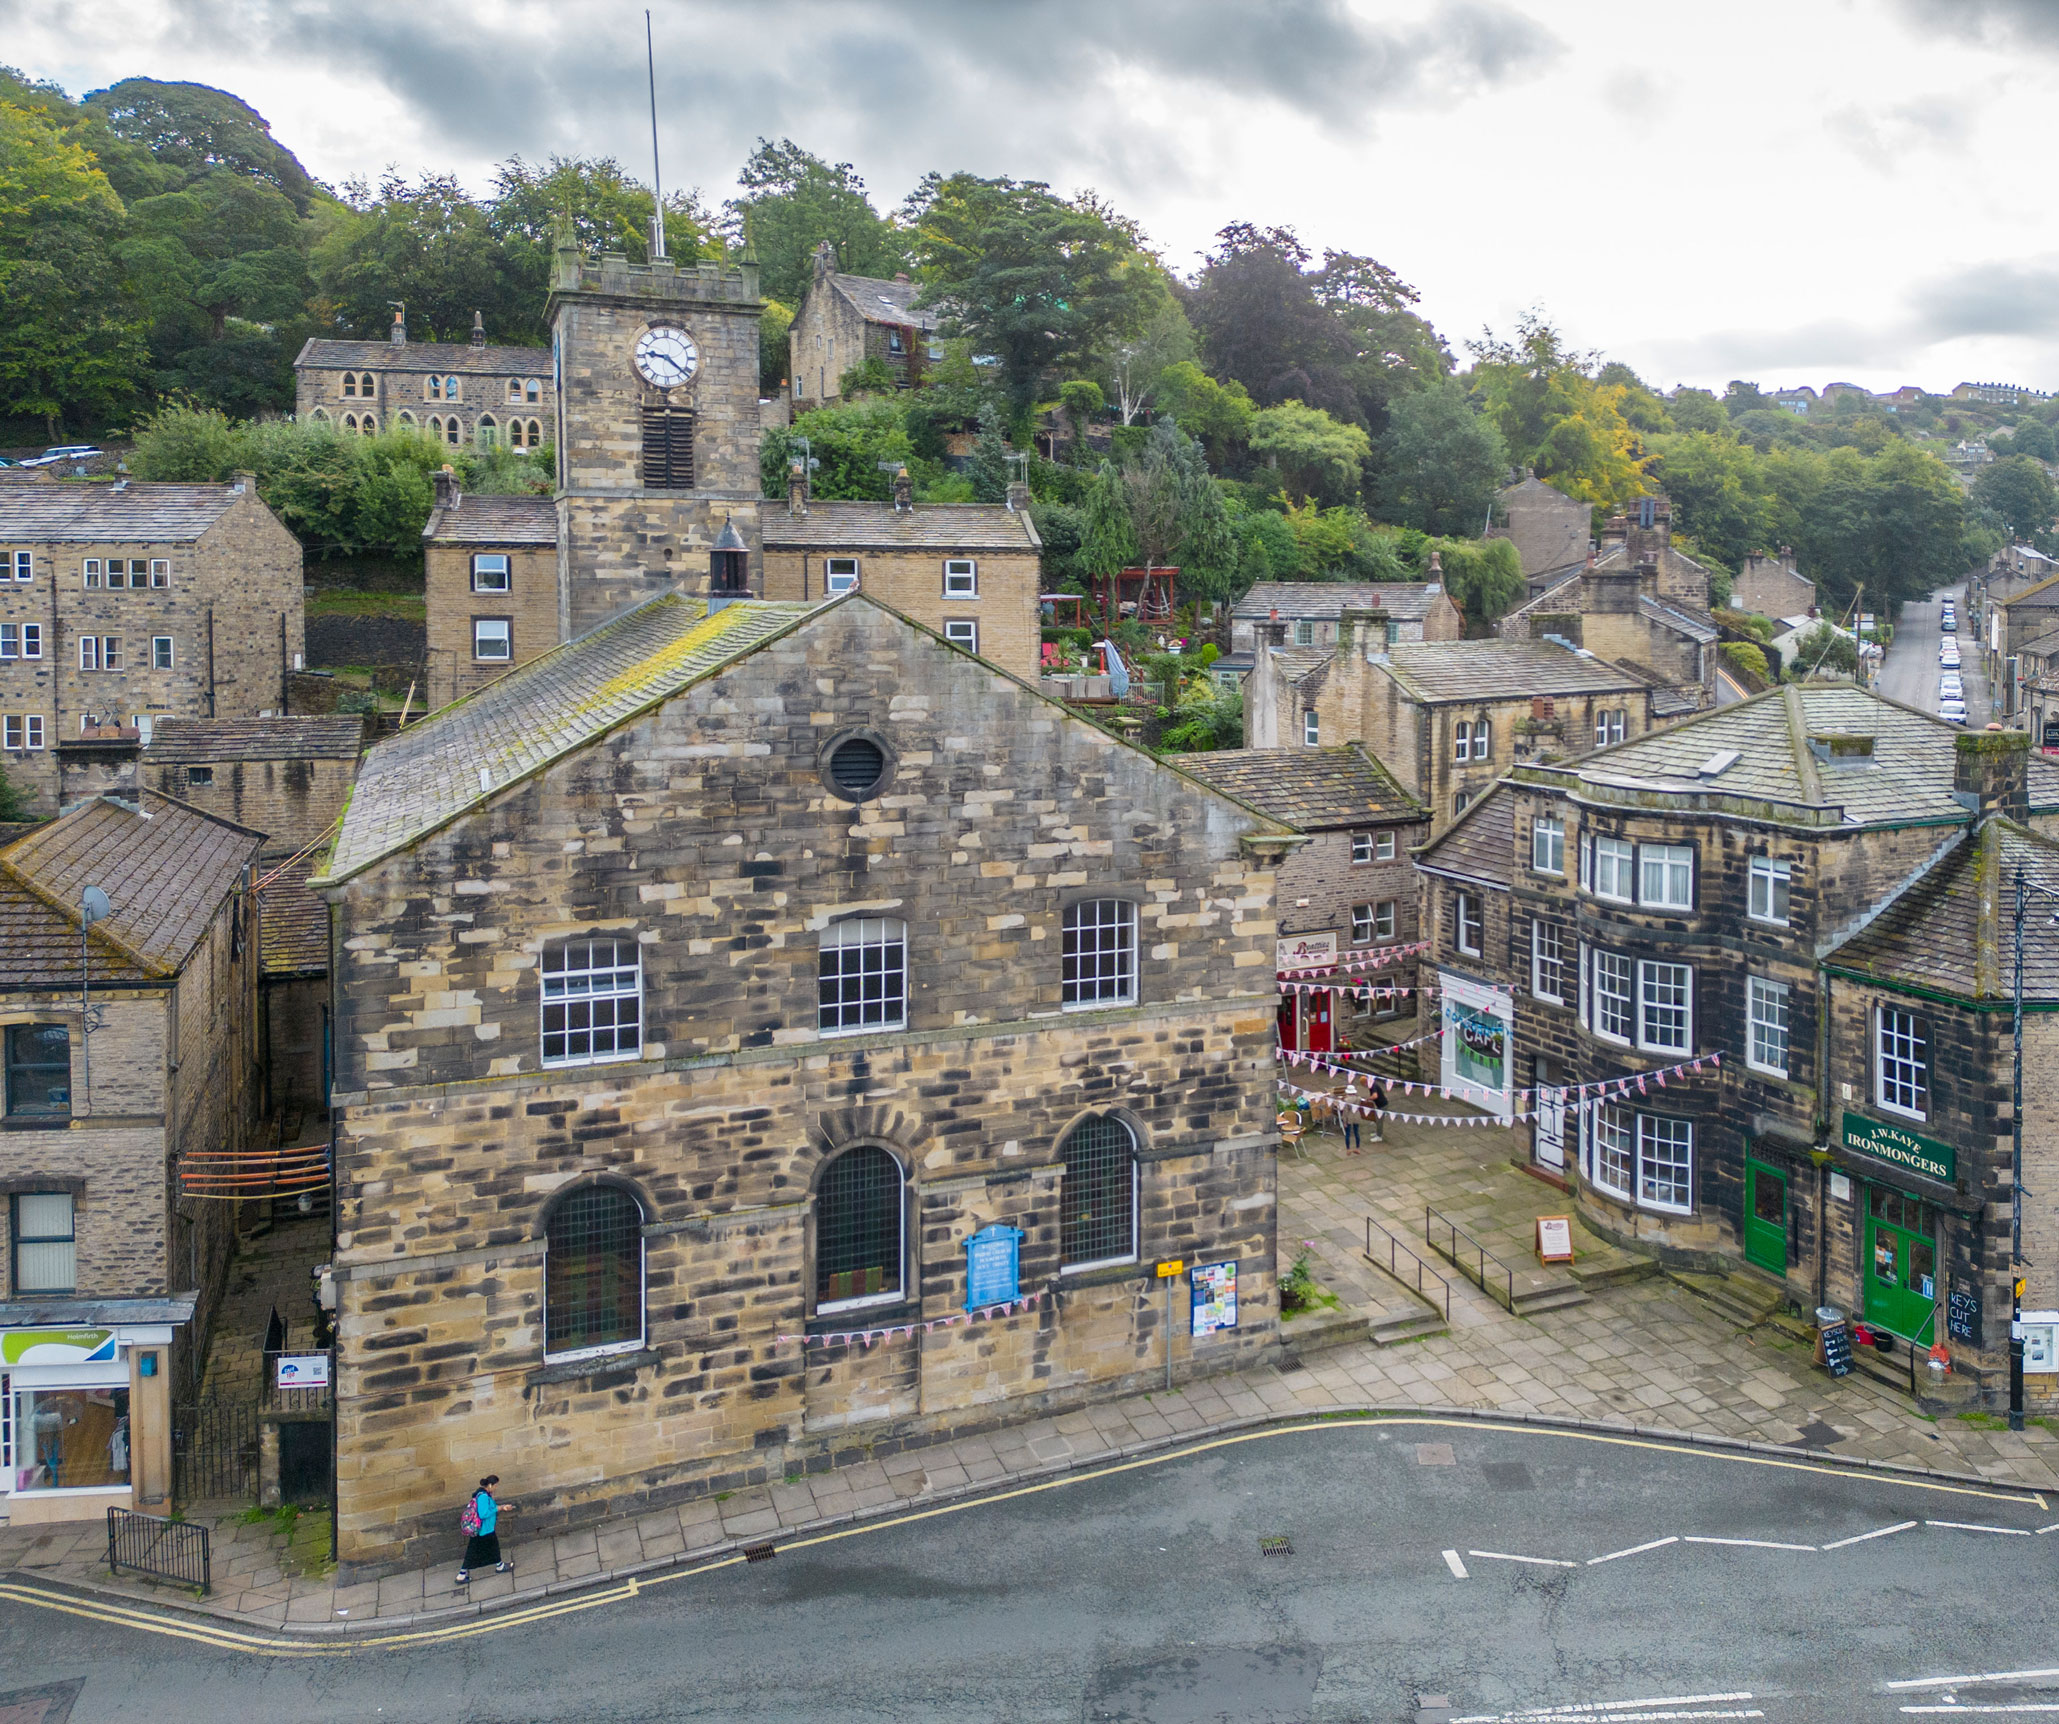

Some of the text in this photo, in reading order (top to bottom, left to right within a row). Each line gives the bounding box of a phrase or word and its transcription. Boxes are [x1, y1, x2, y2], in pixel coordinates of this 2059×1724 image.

[1870, 1128, 1922, 1154] J.W.KAYE
[1847, 1132, 1947, 1177] IRONMONGERS
[1951, 1292, 1977, 1313] KEYS
[1950, 1306, 1970, 1323] CUT
[1950, 1320, 1972, 1338] HERE
